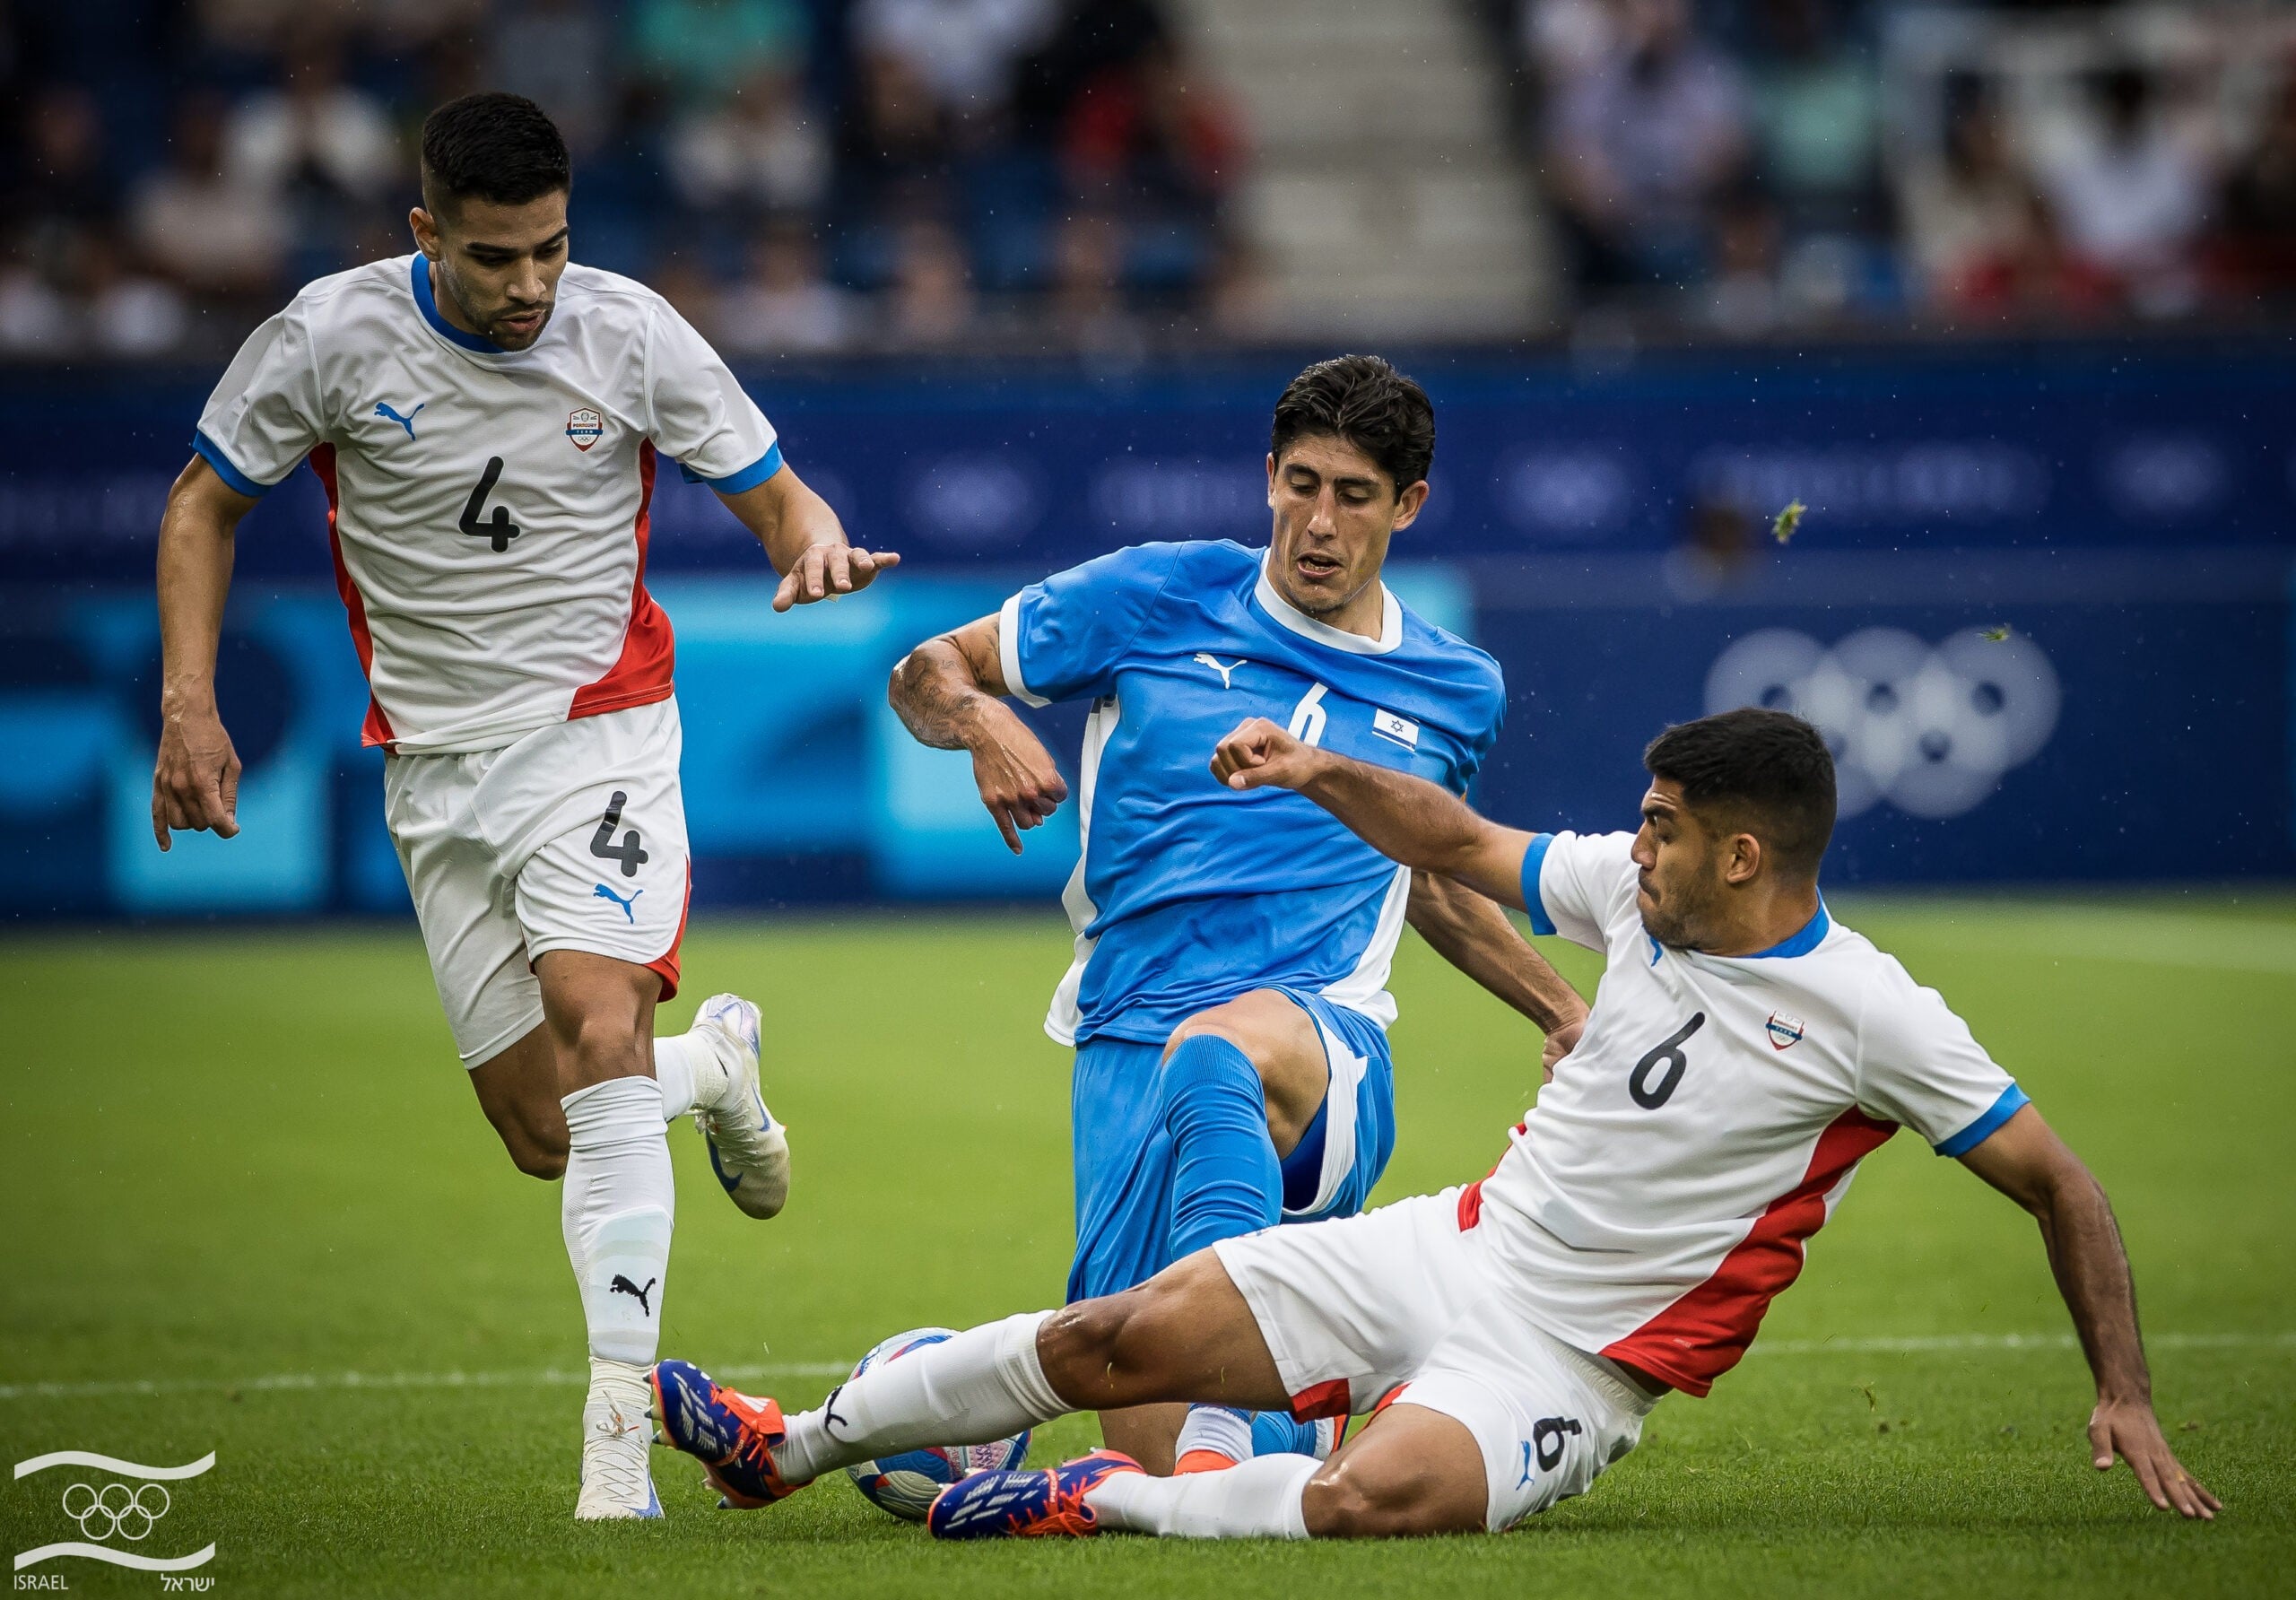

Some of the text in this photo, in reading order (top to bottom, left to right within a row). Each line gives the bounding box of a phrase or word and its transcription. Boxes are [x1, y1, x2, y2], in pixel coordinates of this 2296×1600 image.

[458, 456, 520, 553] 4
[1287, 682, 1328, 748] 6
[589, 790, 648, 878] 4
[1629, 1011, 1706, 1110] 6
[1533, 1416, 1582, 1473] 6
